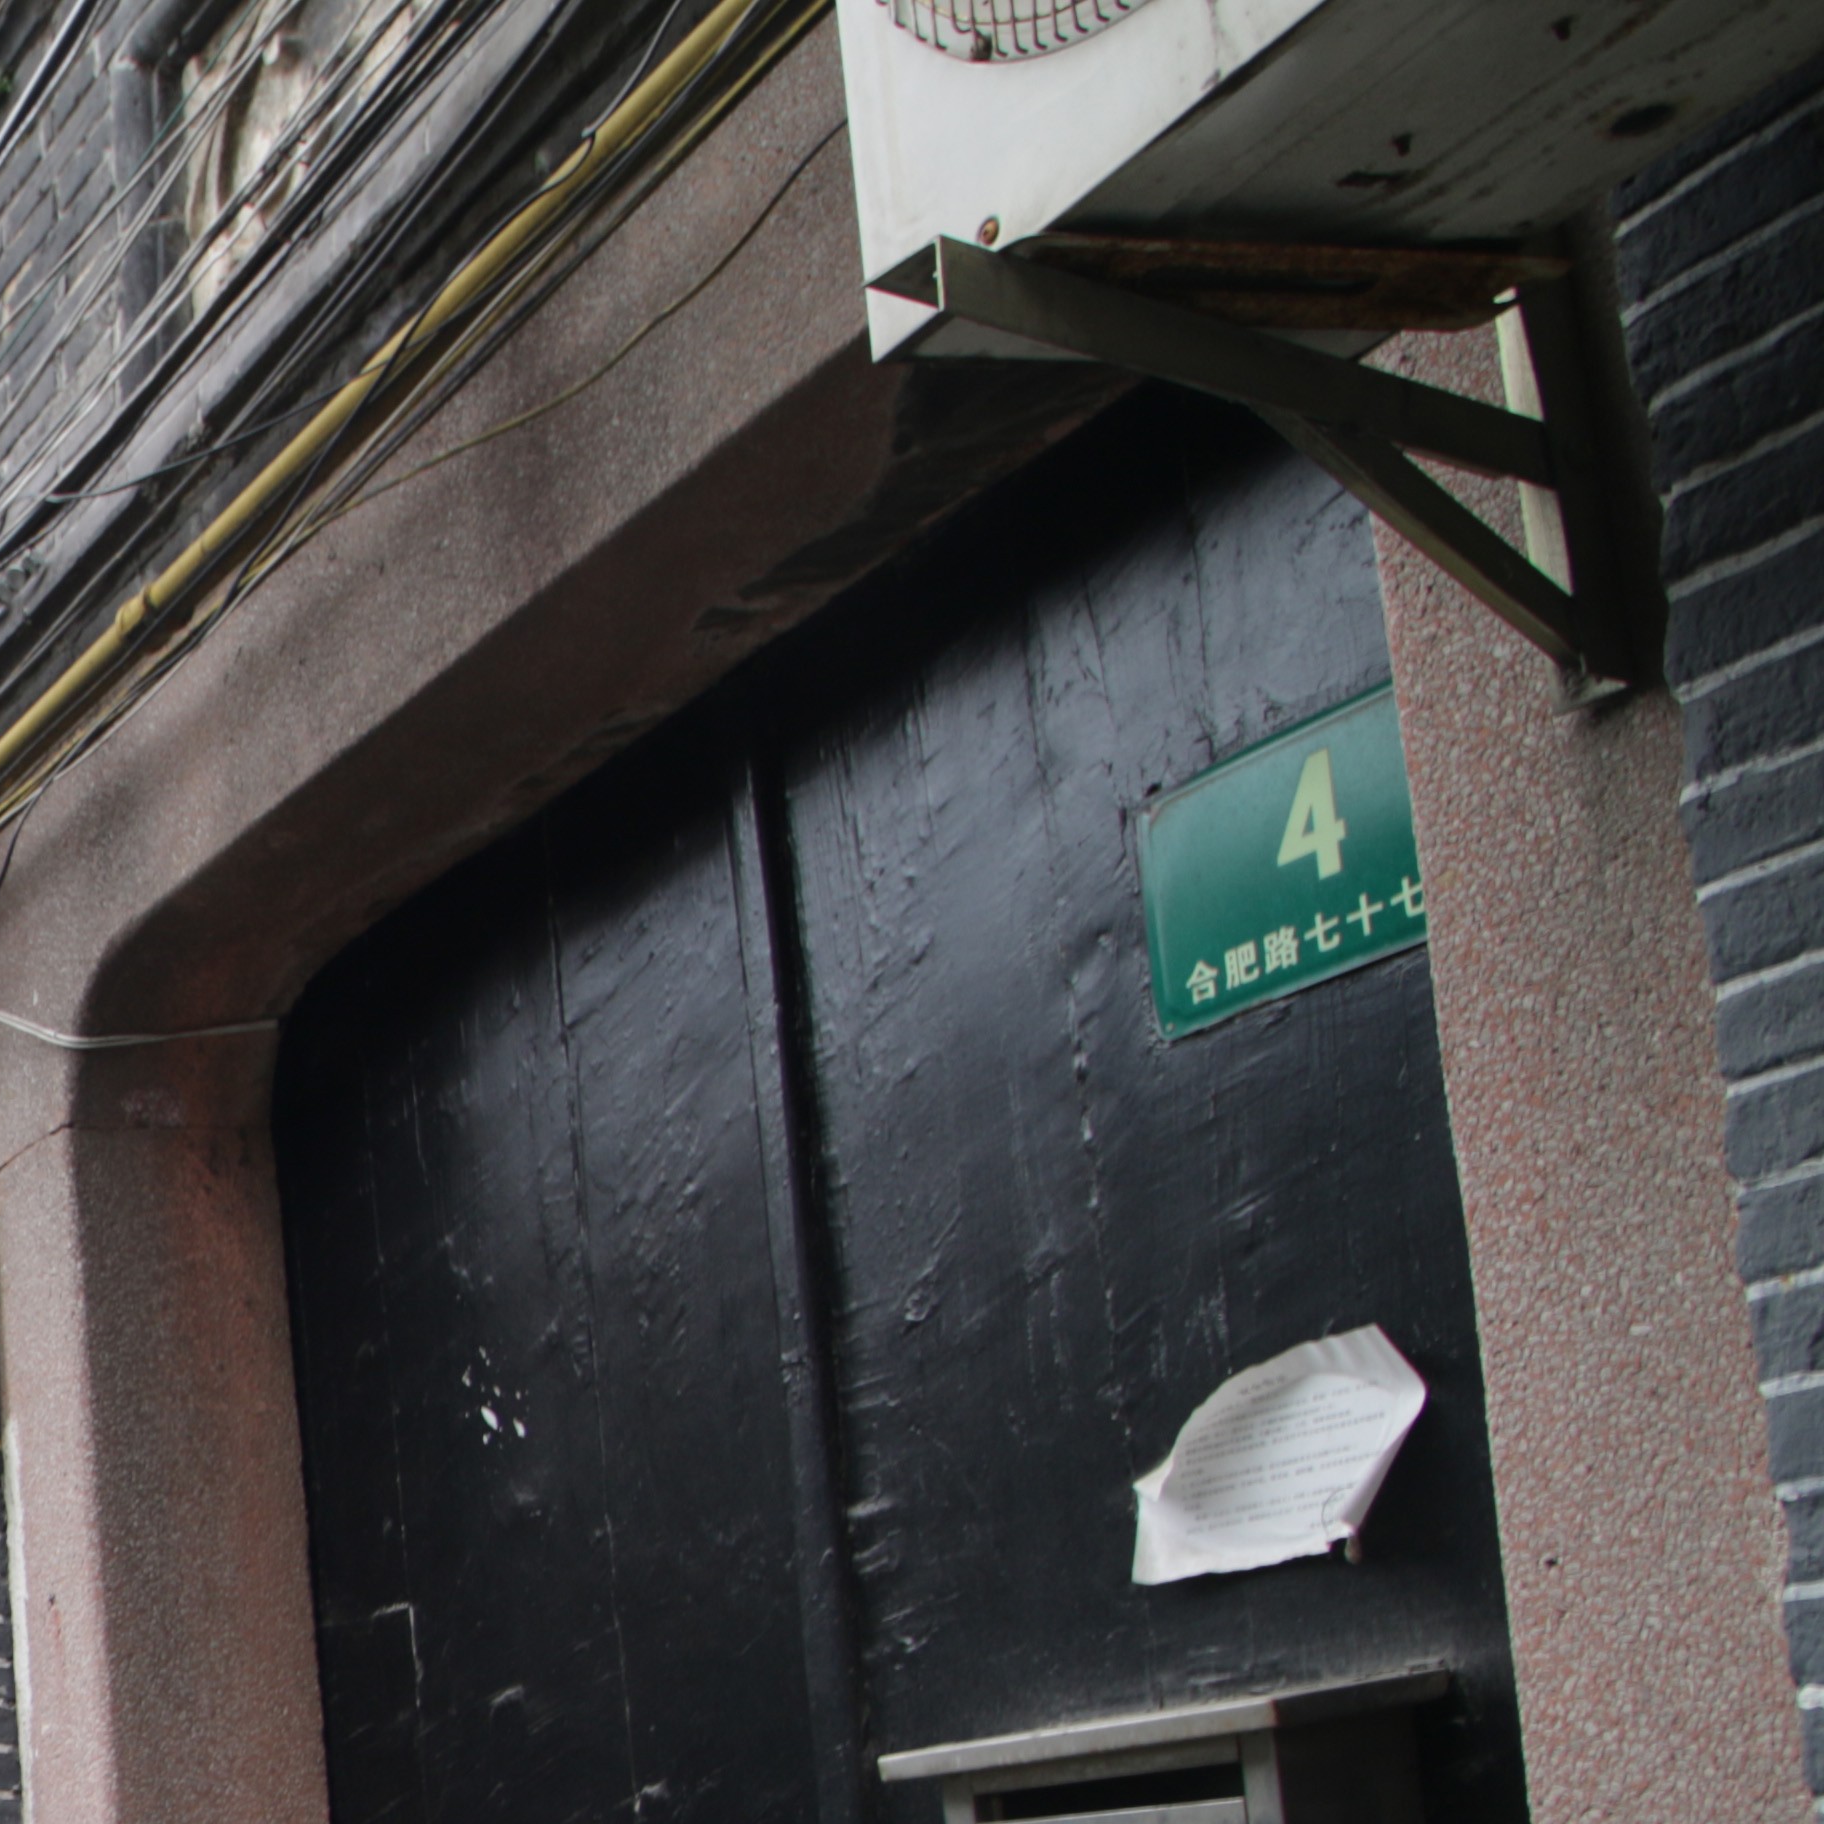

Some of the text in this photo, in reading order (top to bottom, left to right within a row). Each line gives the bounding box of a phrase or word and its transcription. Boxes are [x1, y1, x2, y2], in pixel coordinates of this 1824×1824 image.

[1277, 748, 1347, 881] 4
[1185, 875, 1426, 1005] 合肥路七十七
